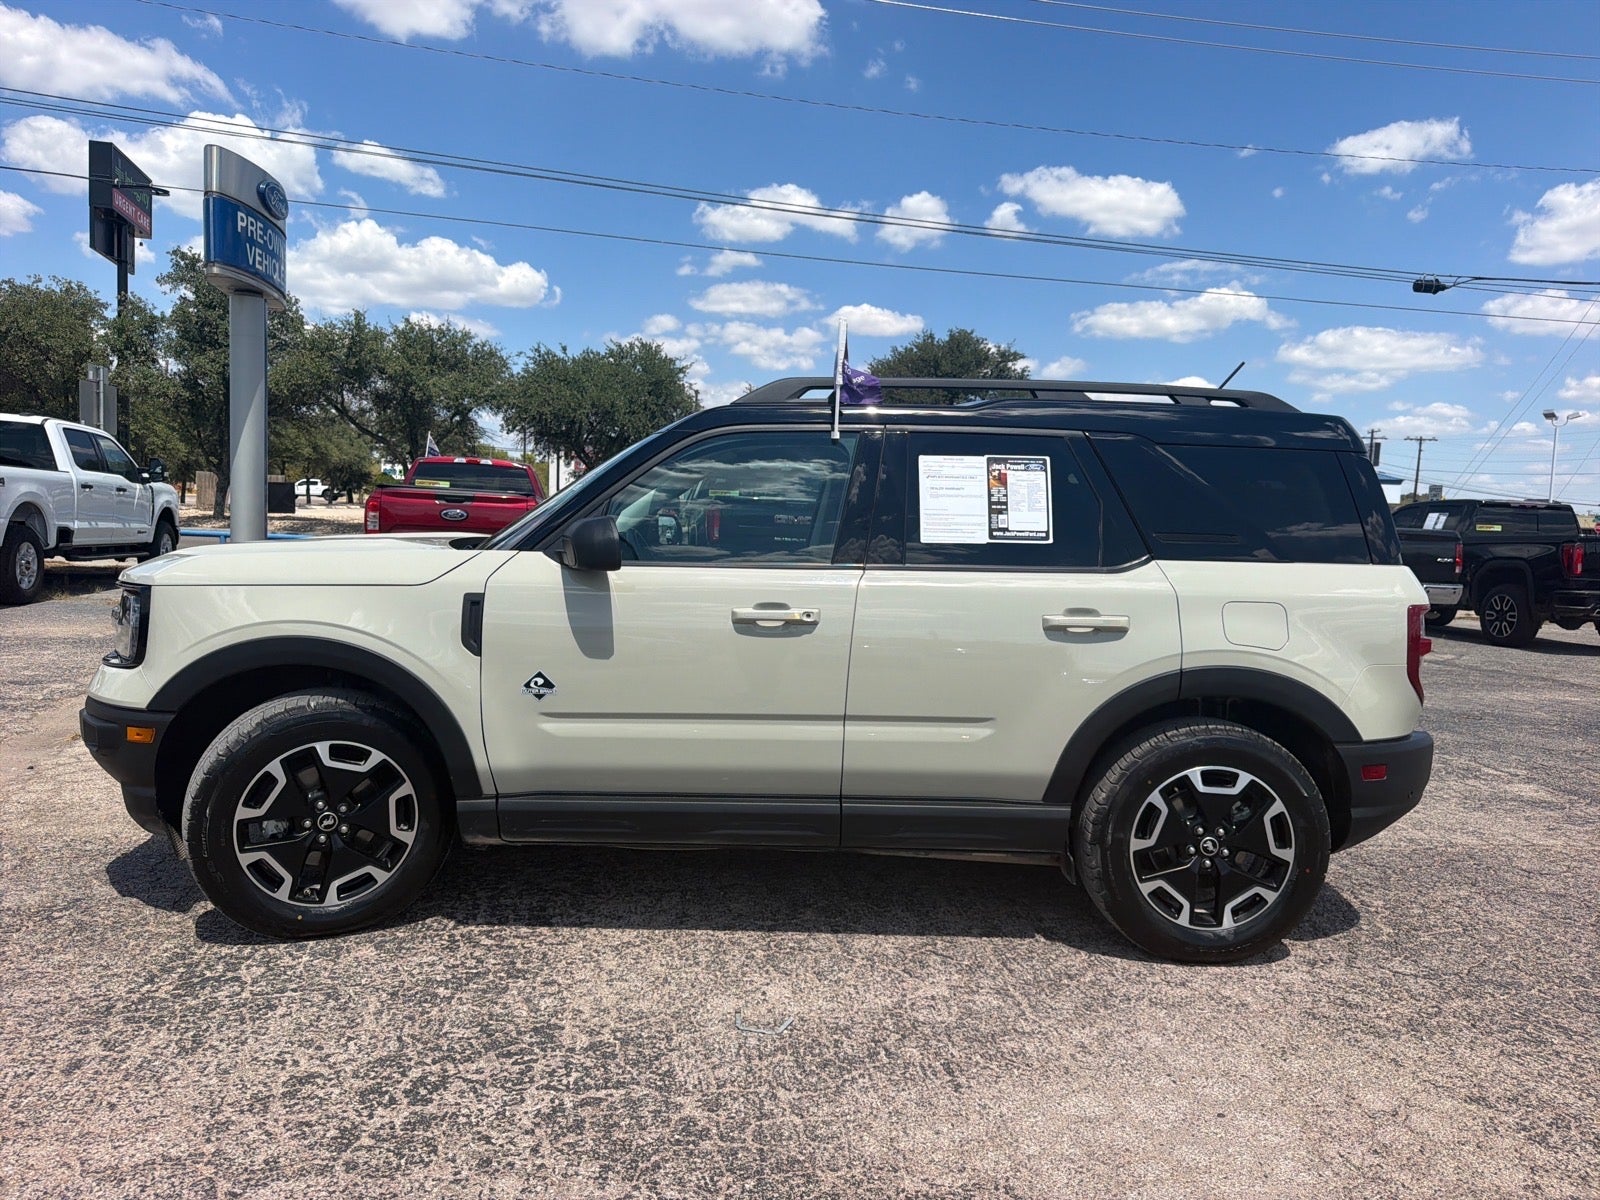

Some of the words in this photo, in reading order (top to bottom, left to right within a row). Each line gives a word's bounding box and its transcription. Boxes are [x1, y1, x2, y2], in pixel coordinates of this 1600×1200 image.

[113, 195, 136, 218] URGENT
[137, 210, 151, 231] CARE
[774, 514, 813, 525] GMC
